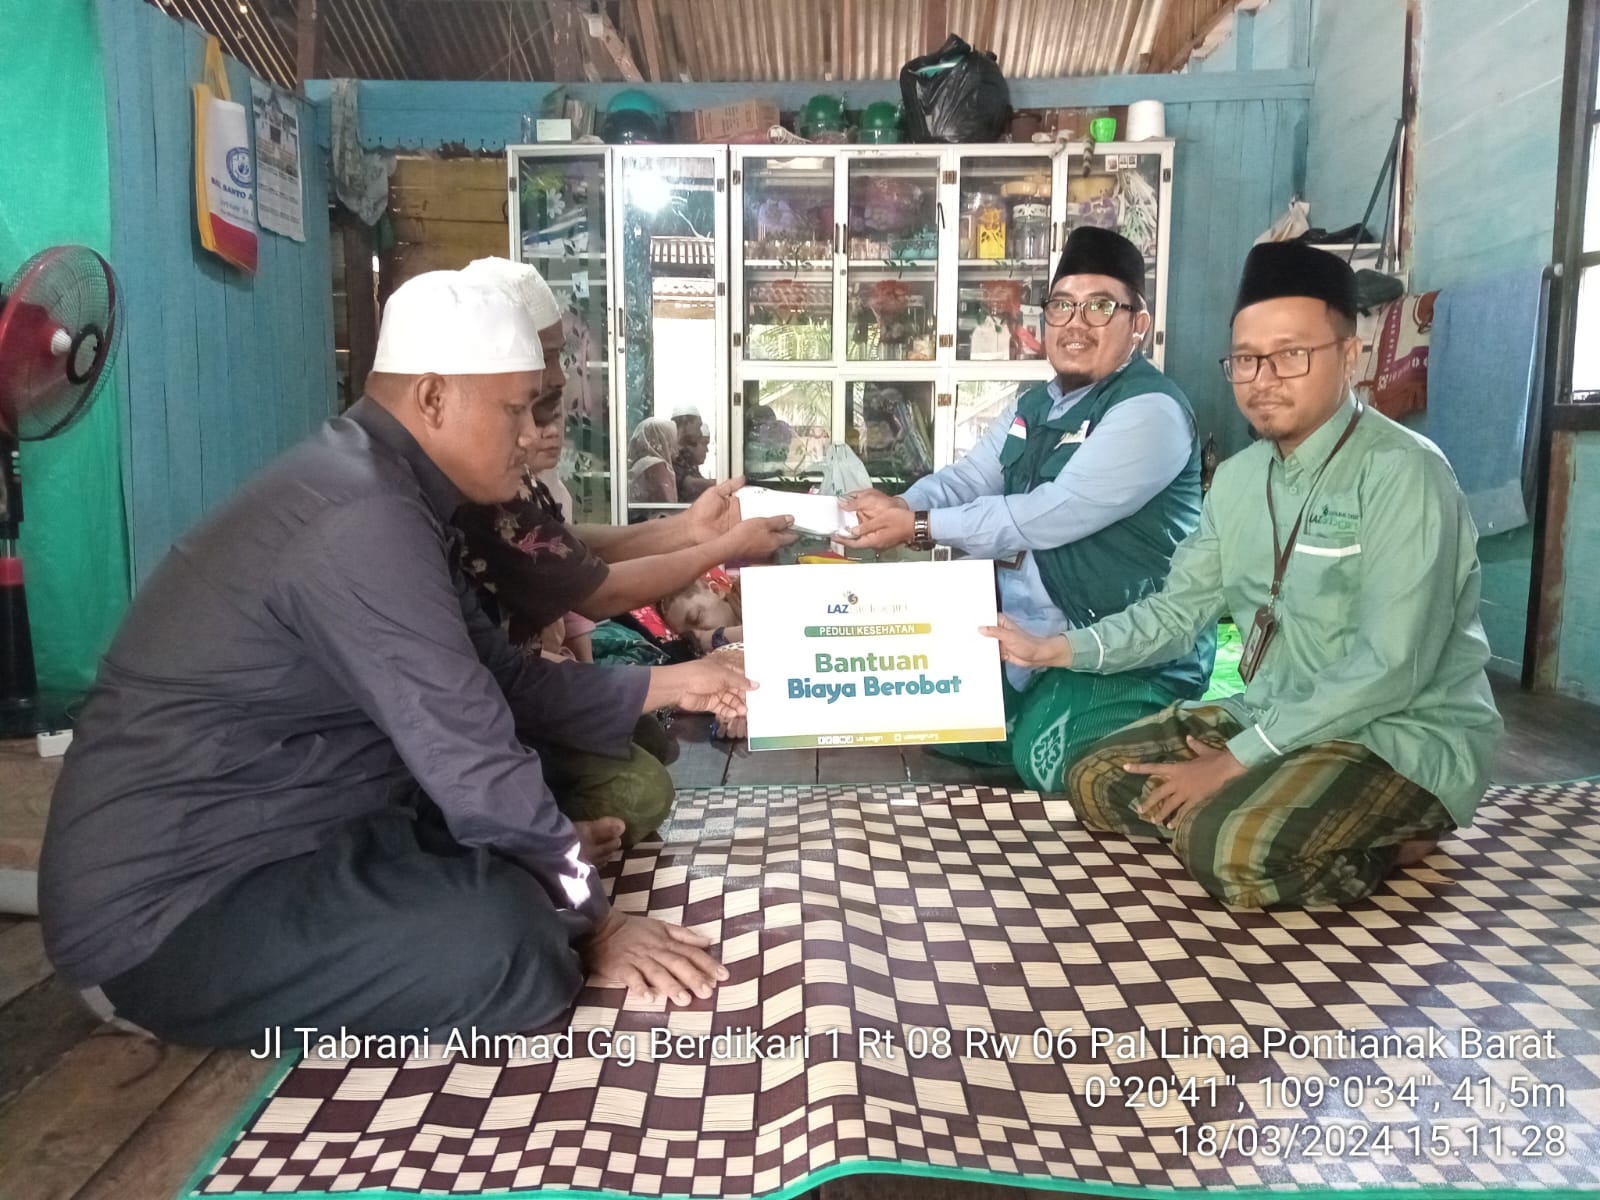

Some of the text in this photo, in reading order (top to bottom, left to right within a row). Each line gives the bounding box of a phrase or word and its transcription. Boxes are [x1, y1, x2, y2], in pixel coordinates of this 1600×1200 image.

[827, 604, 849, 614] LAZ
[819, 624, 915, 636] PEDULI KESEHATAN
[815, 653, 929, 673] Bantuan
[788, 674, 962, 704] Biaya Berobat
